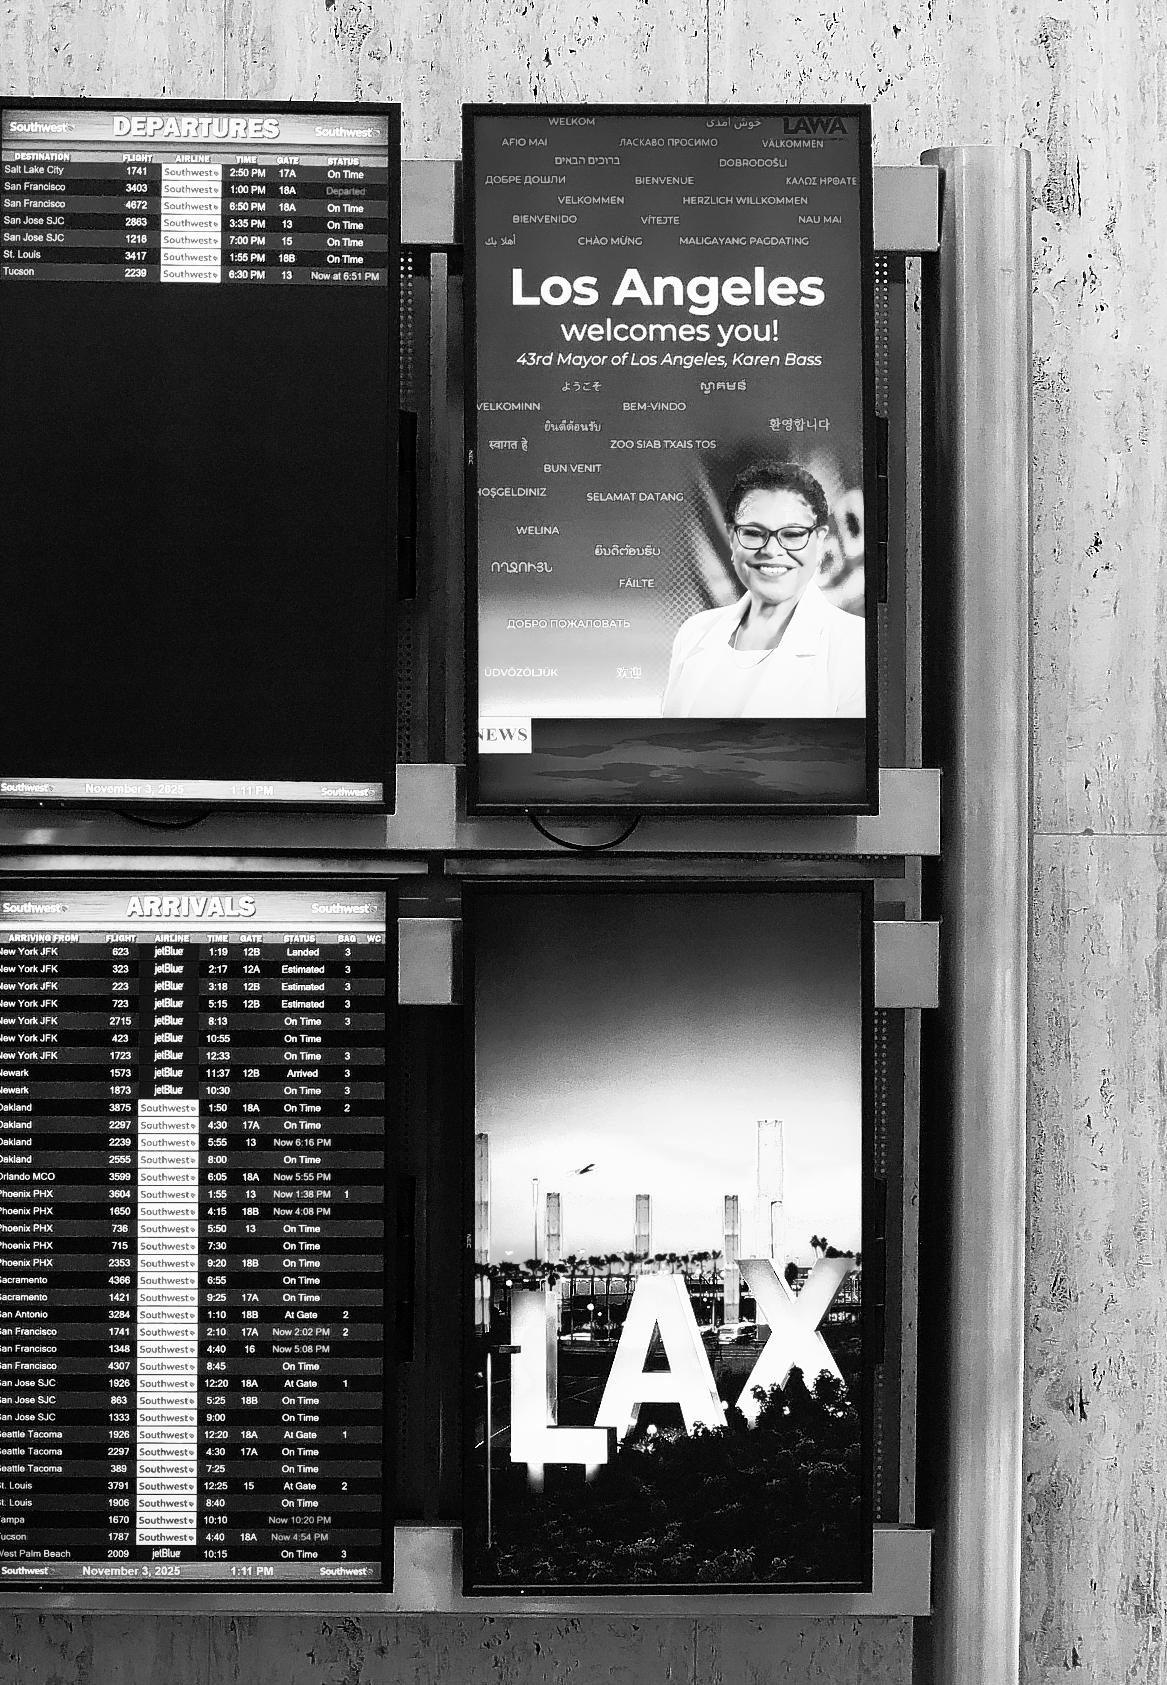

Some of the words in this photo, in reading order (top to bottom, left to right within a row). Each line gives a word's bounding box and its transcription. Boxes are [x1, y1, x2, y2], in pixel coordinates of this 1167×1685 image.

[10, 121, 66, 133] Southwest
[113, 115, 280, 139] DEPARTURES
[783, 117, 848, 134] LAWA
[502, 138, 526, 146] AFIO
[620, 138, 664, 146] ЛАСКАВО
[720, 158, 787, 167] DOBRODOŠLI
[485, 176, 521, 185] ДОБРЕ
[524, 176, 565, 184] ДОШЛИ
[558, 196, 624, 204] VELKOMMEN
[513, 215, 577, 223] BIENVENIDO
[578, 236, 608, 245] CHÀO
[680, 237, 746, 245] MALIGAYANG
[750, 237, 808, 245] PAGDATING
[3, 267, 34, 275] Tucson
[125, 269, 146, 277] 2239
[164, 270, 211, 278] Southwest
[229, 270, 248, 278] 6:30
[251, 270, 265, 279] PM
[282, 271, 292, 279] 13
[344, 272, 361, 280] 6:51
[513, 269, 598, 305] Los
[612, 267, 824, 315] Angeles
[561, 318, 710, 341] welcomes
[717, 320, 778, 347] you!
[517, 352, 553, 365] 43rd
[558, 353, 608, 368] Mayor
[611, 352, 629, 365] of
[631, 353, 657, 365] Los
[661, 353, 727, 368] Angeles,
[733, 353, 780, 365] Karen
[785, 353, 822, 365] Bass
[562, 382, 601, 391] ようこそ
[477, 402, 540, 410] VELKOMINN
[623, 402, 686, 410] BEM-VINDO
[769, 418, 830, 431] 환영합니다
[611, 440, 634, 448] ZOO
[637, 440, 661, 448] SIAB
[663, 440, 693, 448] TXAIS
[695, 440, 716, 448] TOS
[544, 464, 567, 472] BUN
[570, 464, 601, 472] VENIT
[587, 493, 636, 501] SELAMAT
[639, 493, 683, 501] DATANG
[516, 526, 559, 534] WELINA
[620, 578, 654, 587] FÁILTE
[507, 620, 547, 629] ДОБРО
[551, 620, 630, 628] ПОЖАЛОВАТЬ
[3, 902, 60, 914] Southwest
[126, 895, 256, 918] ARRIVALS
[9, 934, 51, 943] ARRIVING
[53, 934, 79, 943] FROM
[106, 934, 136, 943] FLIGHT
[155, 934, 190, 943] AIRLINE
[207, 934, 229, 943] TIME
[240, 934, 263, 943] GATE
[284, 934, 316, 943] STATUS
[511, 1258, 850, 1465] LAX
[38, 1413, 55, 1421] SJC
[109, 1413, 129, 1421] 1333
[140, 1414, 188, 1422] Southwest
[152, 1548, 181, 1560] jetBlue
[204, 1550, 227, 1558] 10:15
[281, 1550, 294, 1558] On
[296, 1550, 318, 1558] Time
[341, 1550, 346, 1558] 3
[2, 1567, 49, 1575] Southwest
[83, 1566, 139, 1575] November
[142, 1566, 151, 1577] 3,
[155, 1566, 180, 1575] 2025
[231, 1566, 252, 1576] 1:11
[256, 1566, 274, 1576] PM
